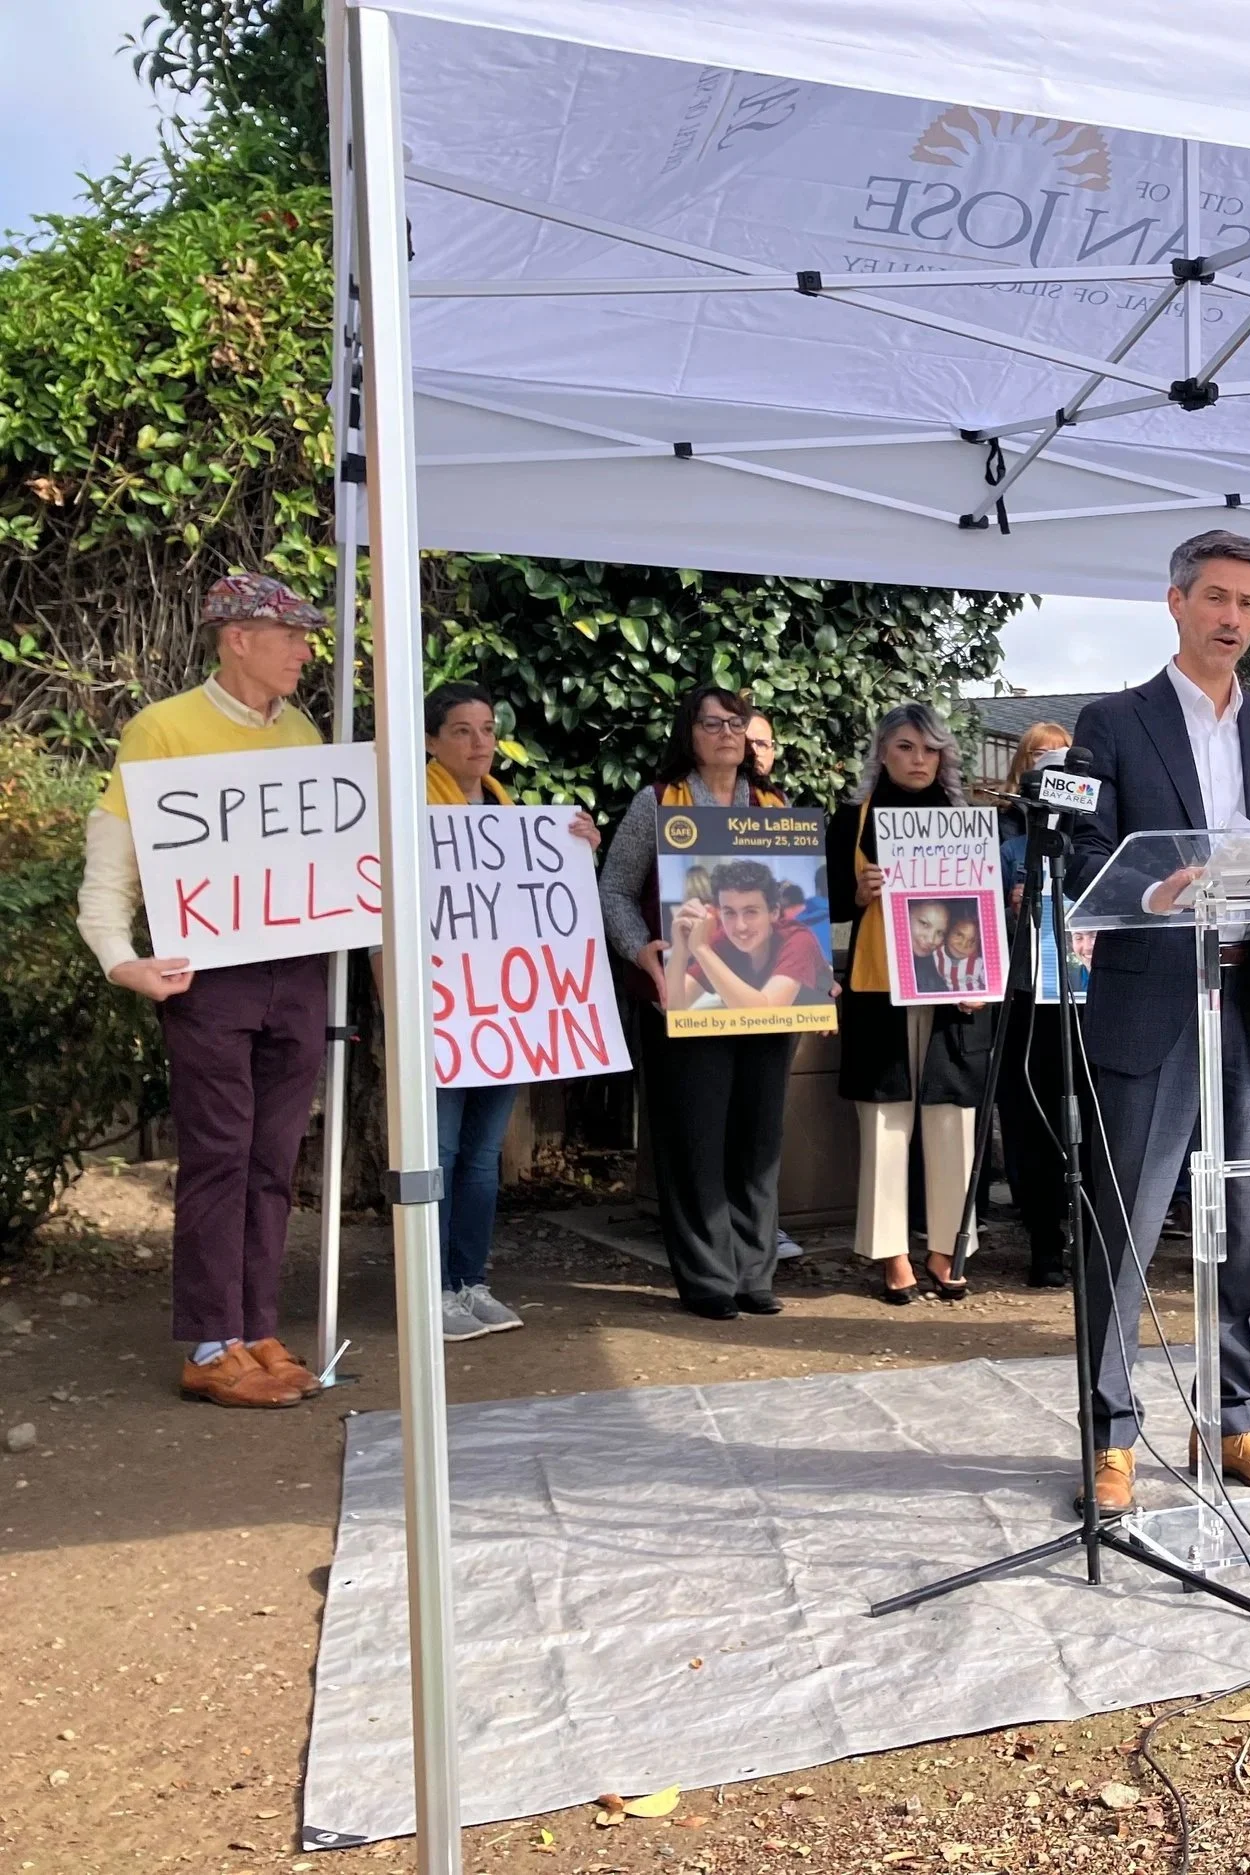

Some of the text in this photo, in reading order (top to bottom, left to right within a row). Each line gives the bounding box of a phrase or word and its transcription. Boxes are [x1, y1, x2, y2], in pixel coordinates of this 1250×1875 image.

[1042, 790, 1093, 806] BAY AREA
[1044, 777, 1076, 793] NBC
[152, 777, 367, 850] SPEED
[728, 818, 818, 834] Kyle LaBlanc
[878, 810, 994, 840] SLOW DOWN
[429, 814, 563, 873] HIS IS
[671, 828, 691, 837] SAFE
[732, 836, 819, 848] January 25, 2016
[892, 837, 989, 861] in memory of
[889, 856, 985, 888] AILEEN
[176, 855, 382, 938] KILLS
[517, 882, 578, 937] TO
[675, 1018, 707, 1029] Killed
[712, 1016, 725, 1030] by
[740, 1015, 793, 1029] Speeding
[797, 1014, 831, 1024] Driver
[434, 1004, 610, 1084] DOWN
